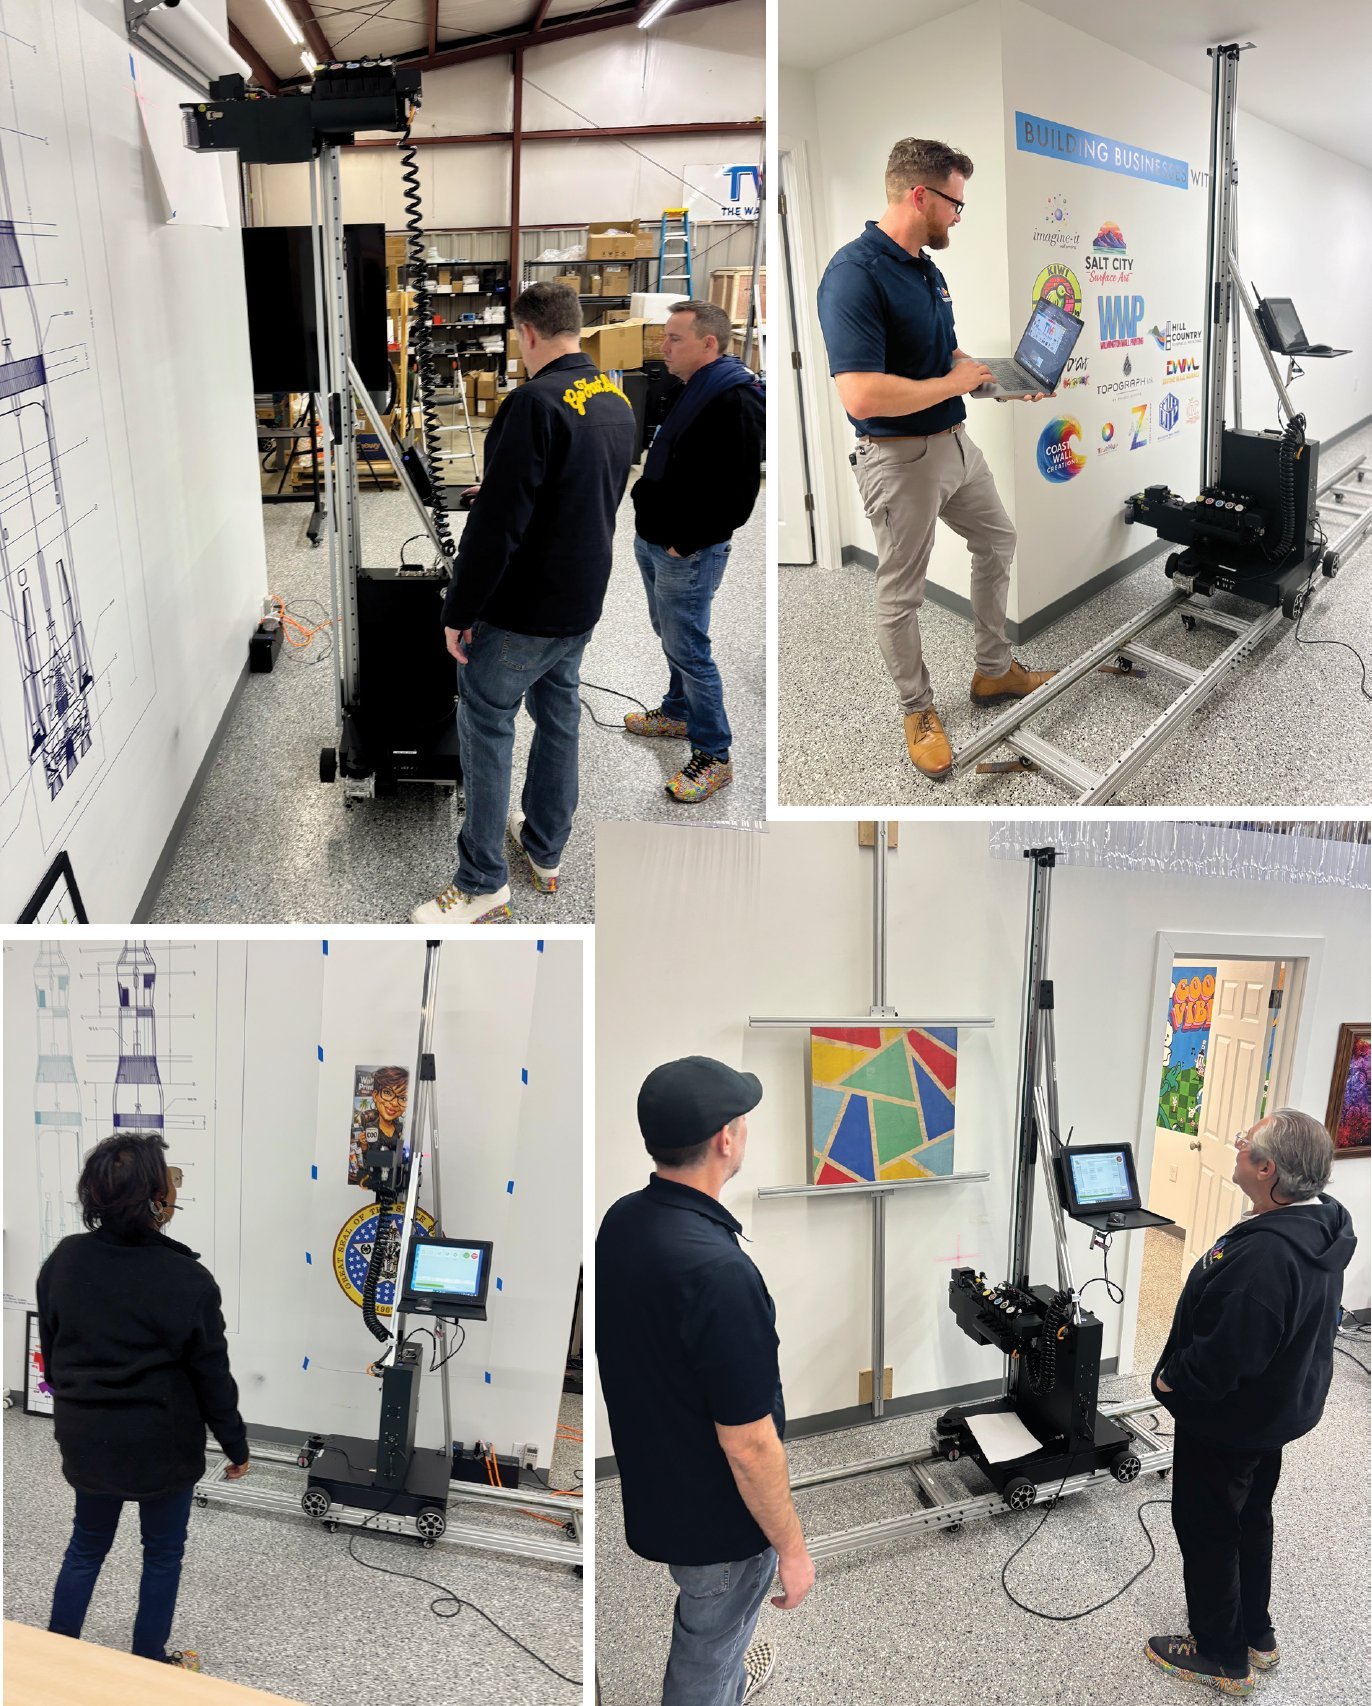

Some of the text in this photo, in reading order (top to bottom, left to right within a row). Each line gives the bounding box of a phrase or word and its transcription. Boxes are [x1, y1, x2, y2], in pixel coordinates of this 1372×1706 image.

[1024, 121, 1108, 163] BUILDING
[1115, 147, 1187, 183] BUSINESSES
[721, 206, 740, 216] THE
[1033, 228, 1080, 246] imagine-it
[1047, 264, 1069, 277] KIWI
[1085, 256, 1134, 271] SALT CITY
[1088, 270, 1131, 286] Surface Art
[1172, 322, 1186, 332] HILL
[1172, 330, 1202, 342] COUNTRY
[1096, 377, 1146, 395] TOPOGRAPH
[1046, 440, 1070, 456] COAST
[1046, 456, 1079, 474] CREATIONS
[1052, 450, 1072, 464] WALL
[1173, 973, 1216, 1003] GOO
[353, 1214, 365, 1225] OF
[338, 1228, 353, 1253] SEAL
[337, 1258, 351, 1290] GREAT
